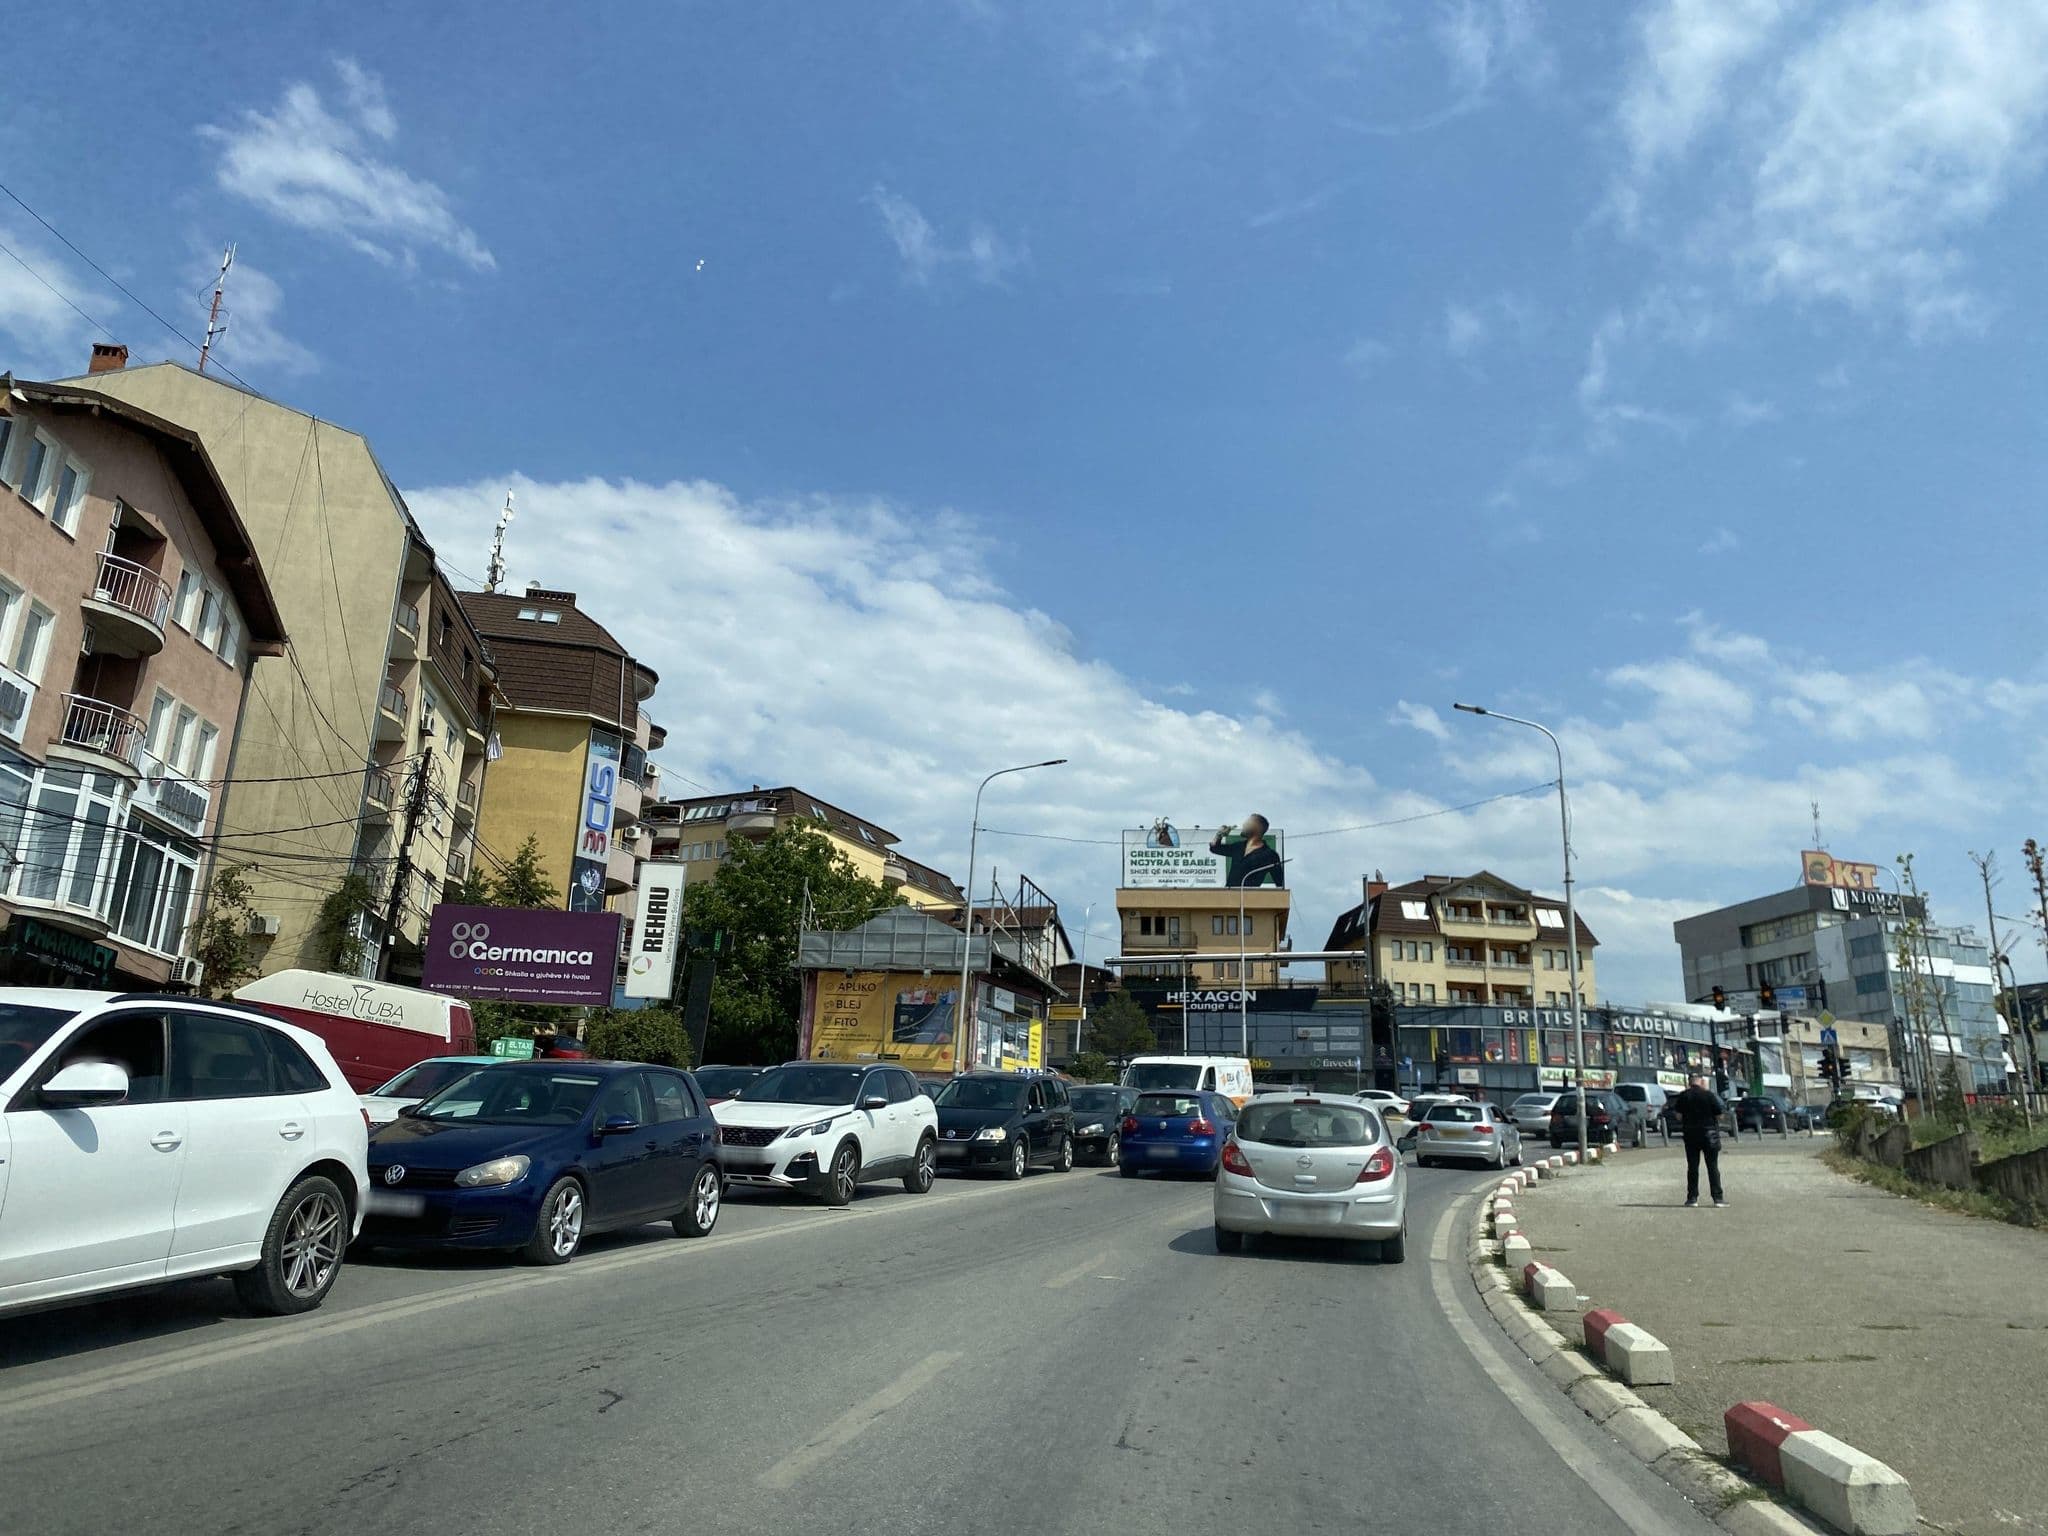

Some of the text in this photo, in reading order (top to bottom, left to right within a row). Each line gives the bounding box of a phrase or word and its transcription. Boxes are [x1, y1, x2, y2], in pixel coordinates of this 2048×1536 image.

[1130, 850, 1194, 858] GREEN OSHT
[1130, 857, 1217, 867] NGJYRA E BABËS
[1802, 851, 1877, 889] BKT
[643, 886, 670, 953] REHAU
[469, 941, 594, 966] Germanica
[504, 970, 529, 978] Shkolla
[571, 973, 591, 981] huaja
[838, 982, 877, 992] APLIKO
[302, 988, 354, 1012] Hostel
[1166, 990, 1257, 1003] HEXAGON
[836, 999, 861, 1010] BLEJ
[834, 1017, 858, 1027] FITO
[1504, 1009, 1588, 1026] BRTISH
[518, 1042, 532, 1050] TAXI
